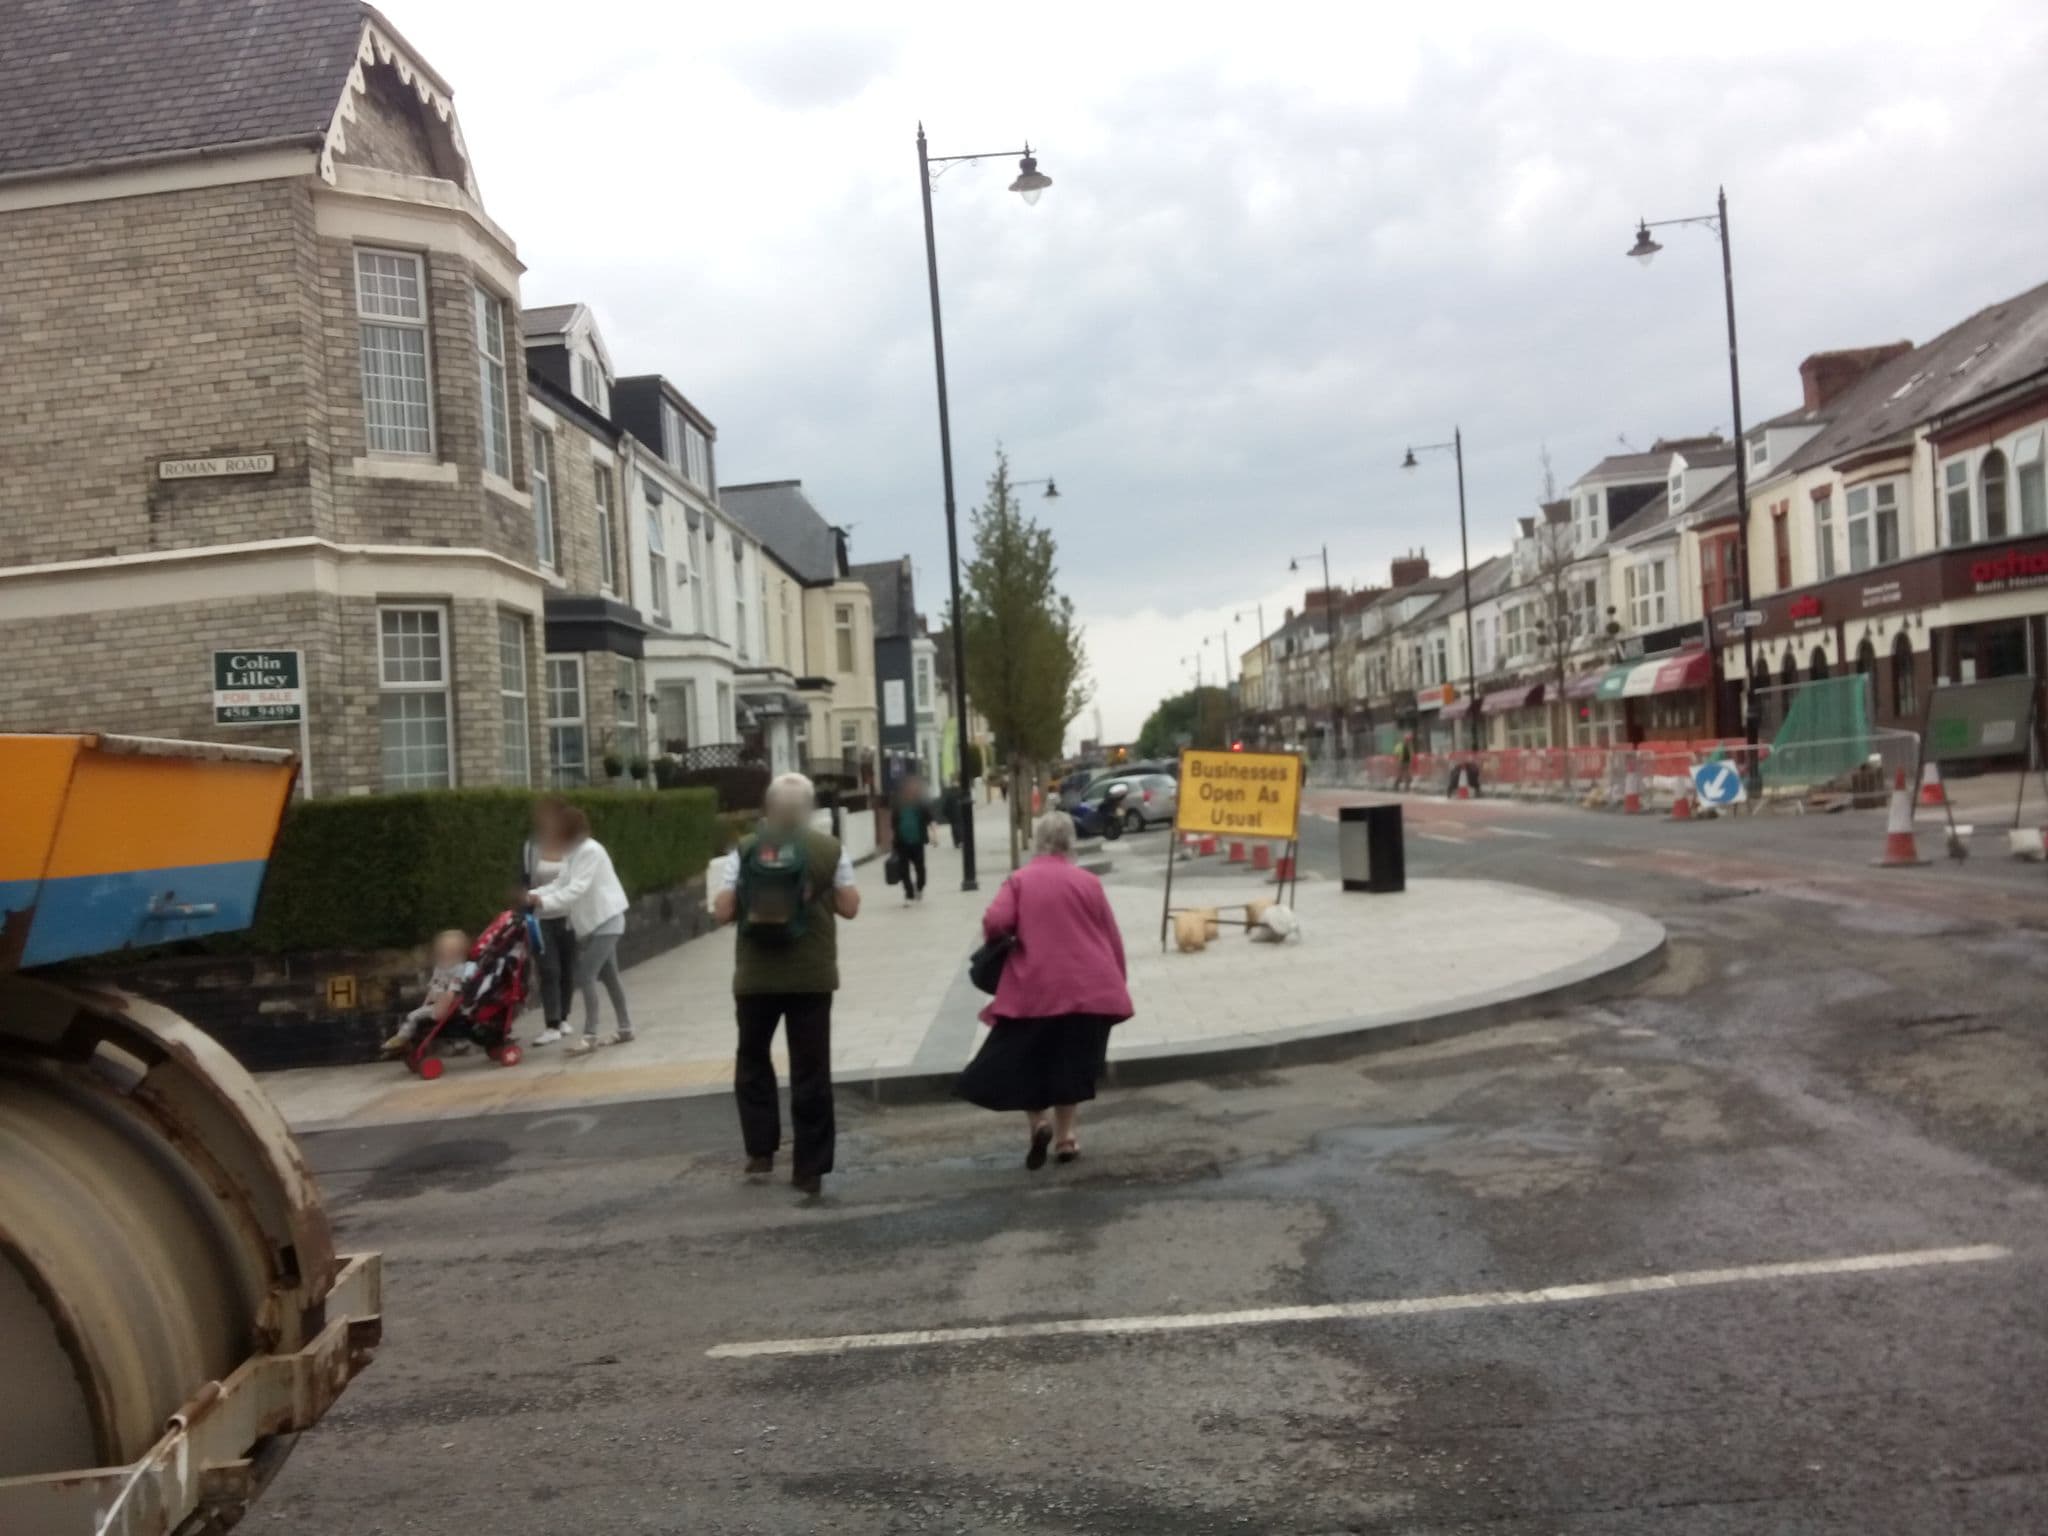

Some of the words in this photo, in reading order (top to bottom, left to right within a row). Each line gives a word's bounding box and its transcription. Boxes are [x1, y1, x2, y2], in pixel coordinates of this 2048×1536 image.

[164, 461, 217, 476] ROMAN
[225, 457, 268, 472] ROAD
[230, 655, 281, 670] Colin
[225, 671, 288, 688] Lilley
[223, 692, 250, 704] FOR
[258, 691, 294, 703] SALE
[223, 706, 250, 717] 456
[257, 704, 294, 716] 9499
[1191, 759, 1288, 781] Businesses
[1199, 783, 1246, 803] Open
[1257, 785, 1280, 803] As
[1210, 808, 1262, 827] Usual
[331, 979, 352, 1005] H
